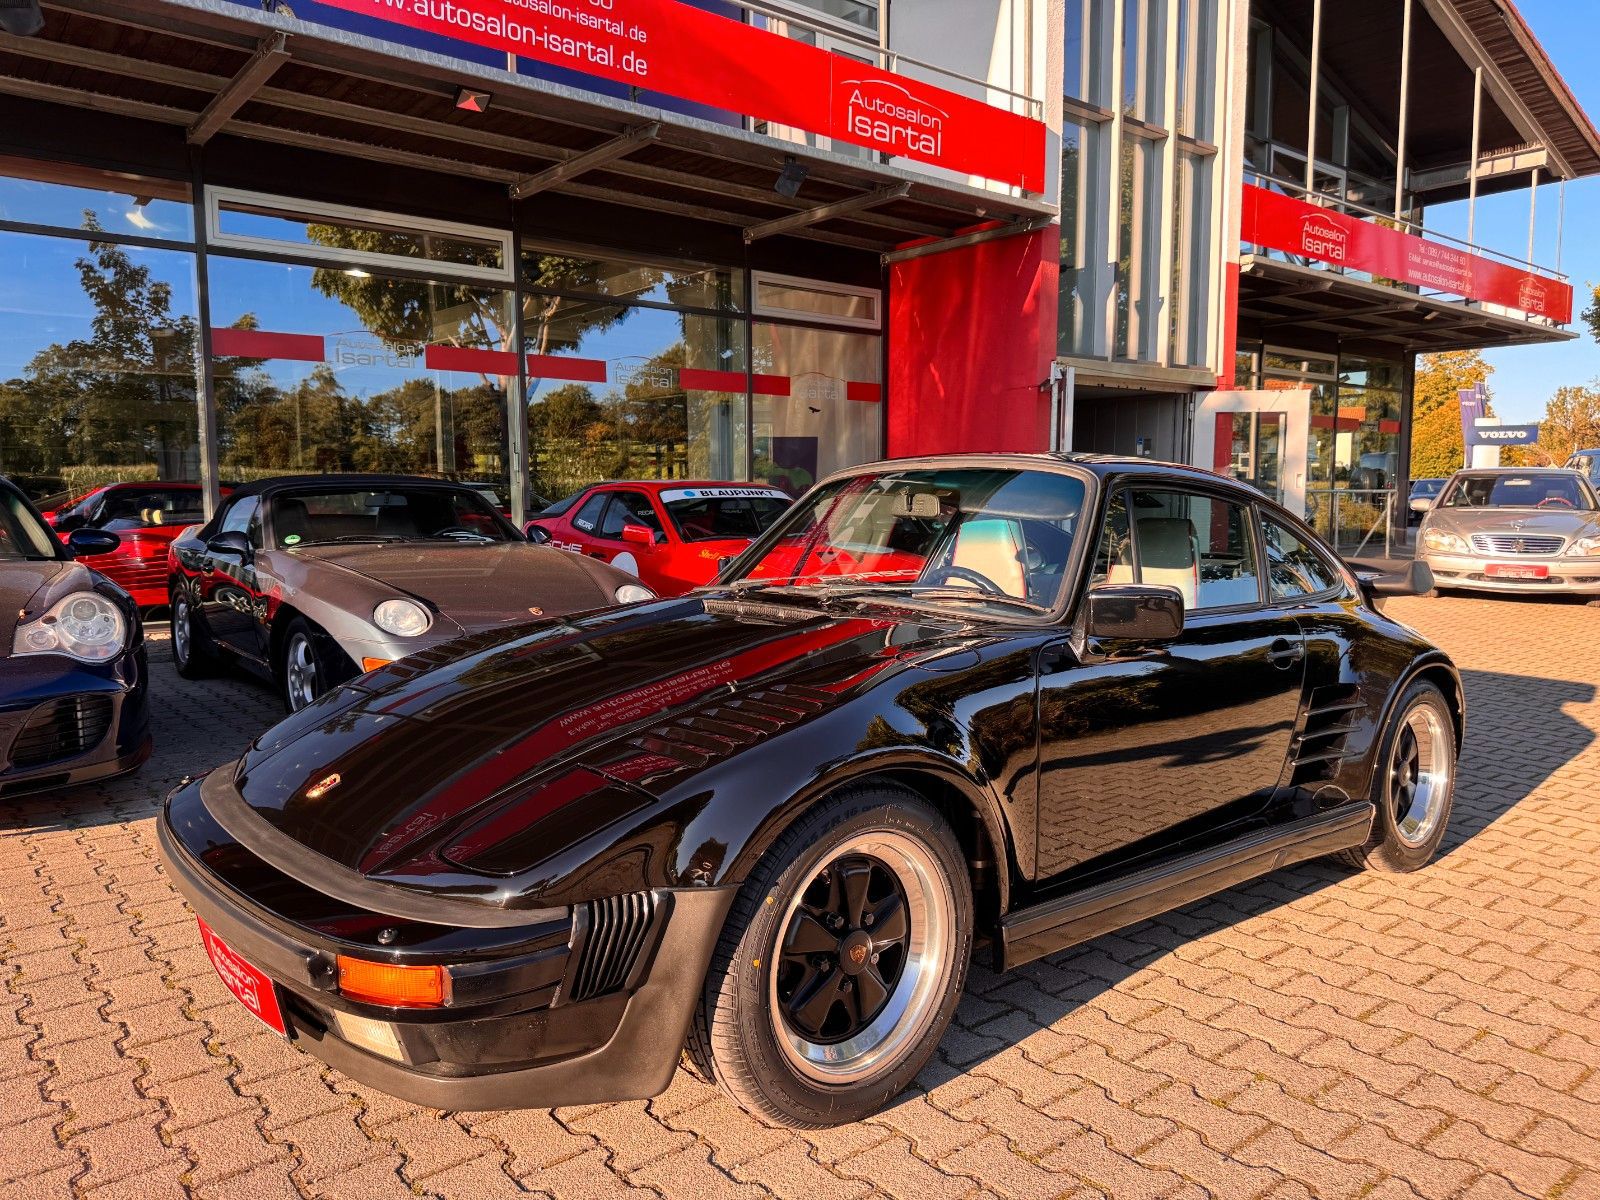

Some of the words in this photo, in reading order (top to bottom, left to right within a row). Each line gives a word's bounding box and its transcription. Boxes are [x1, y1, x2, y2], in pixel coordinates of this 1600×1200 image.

[849, 89, 942, 130] Autosalon
[847, 105, 942, 157] Isartal
[1304, 221, 1346, 243] Autosalon
[1302, 231, 1346, 261] Isartal
[335, 347, 415, 369] Isartal
[615, 370, 673, 389] Isartal
[1478, 431, 1528, 439] VOLVO
